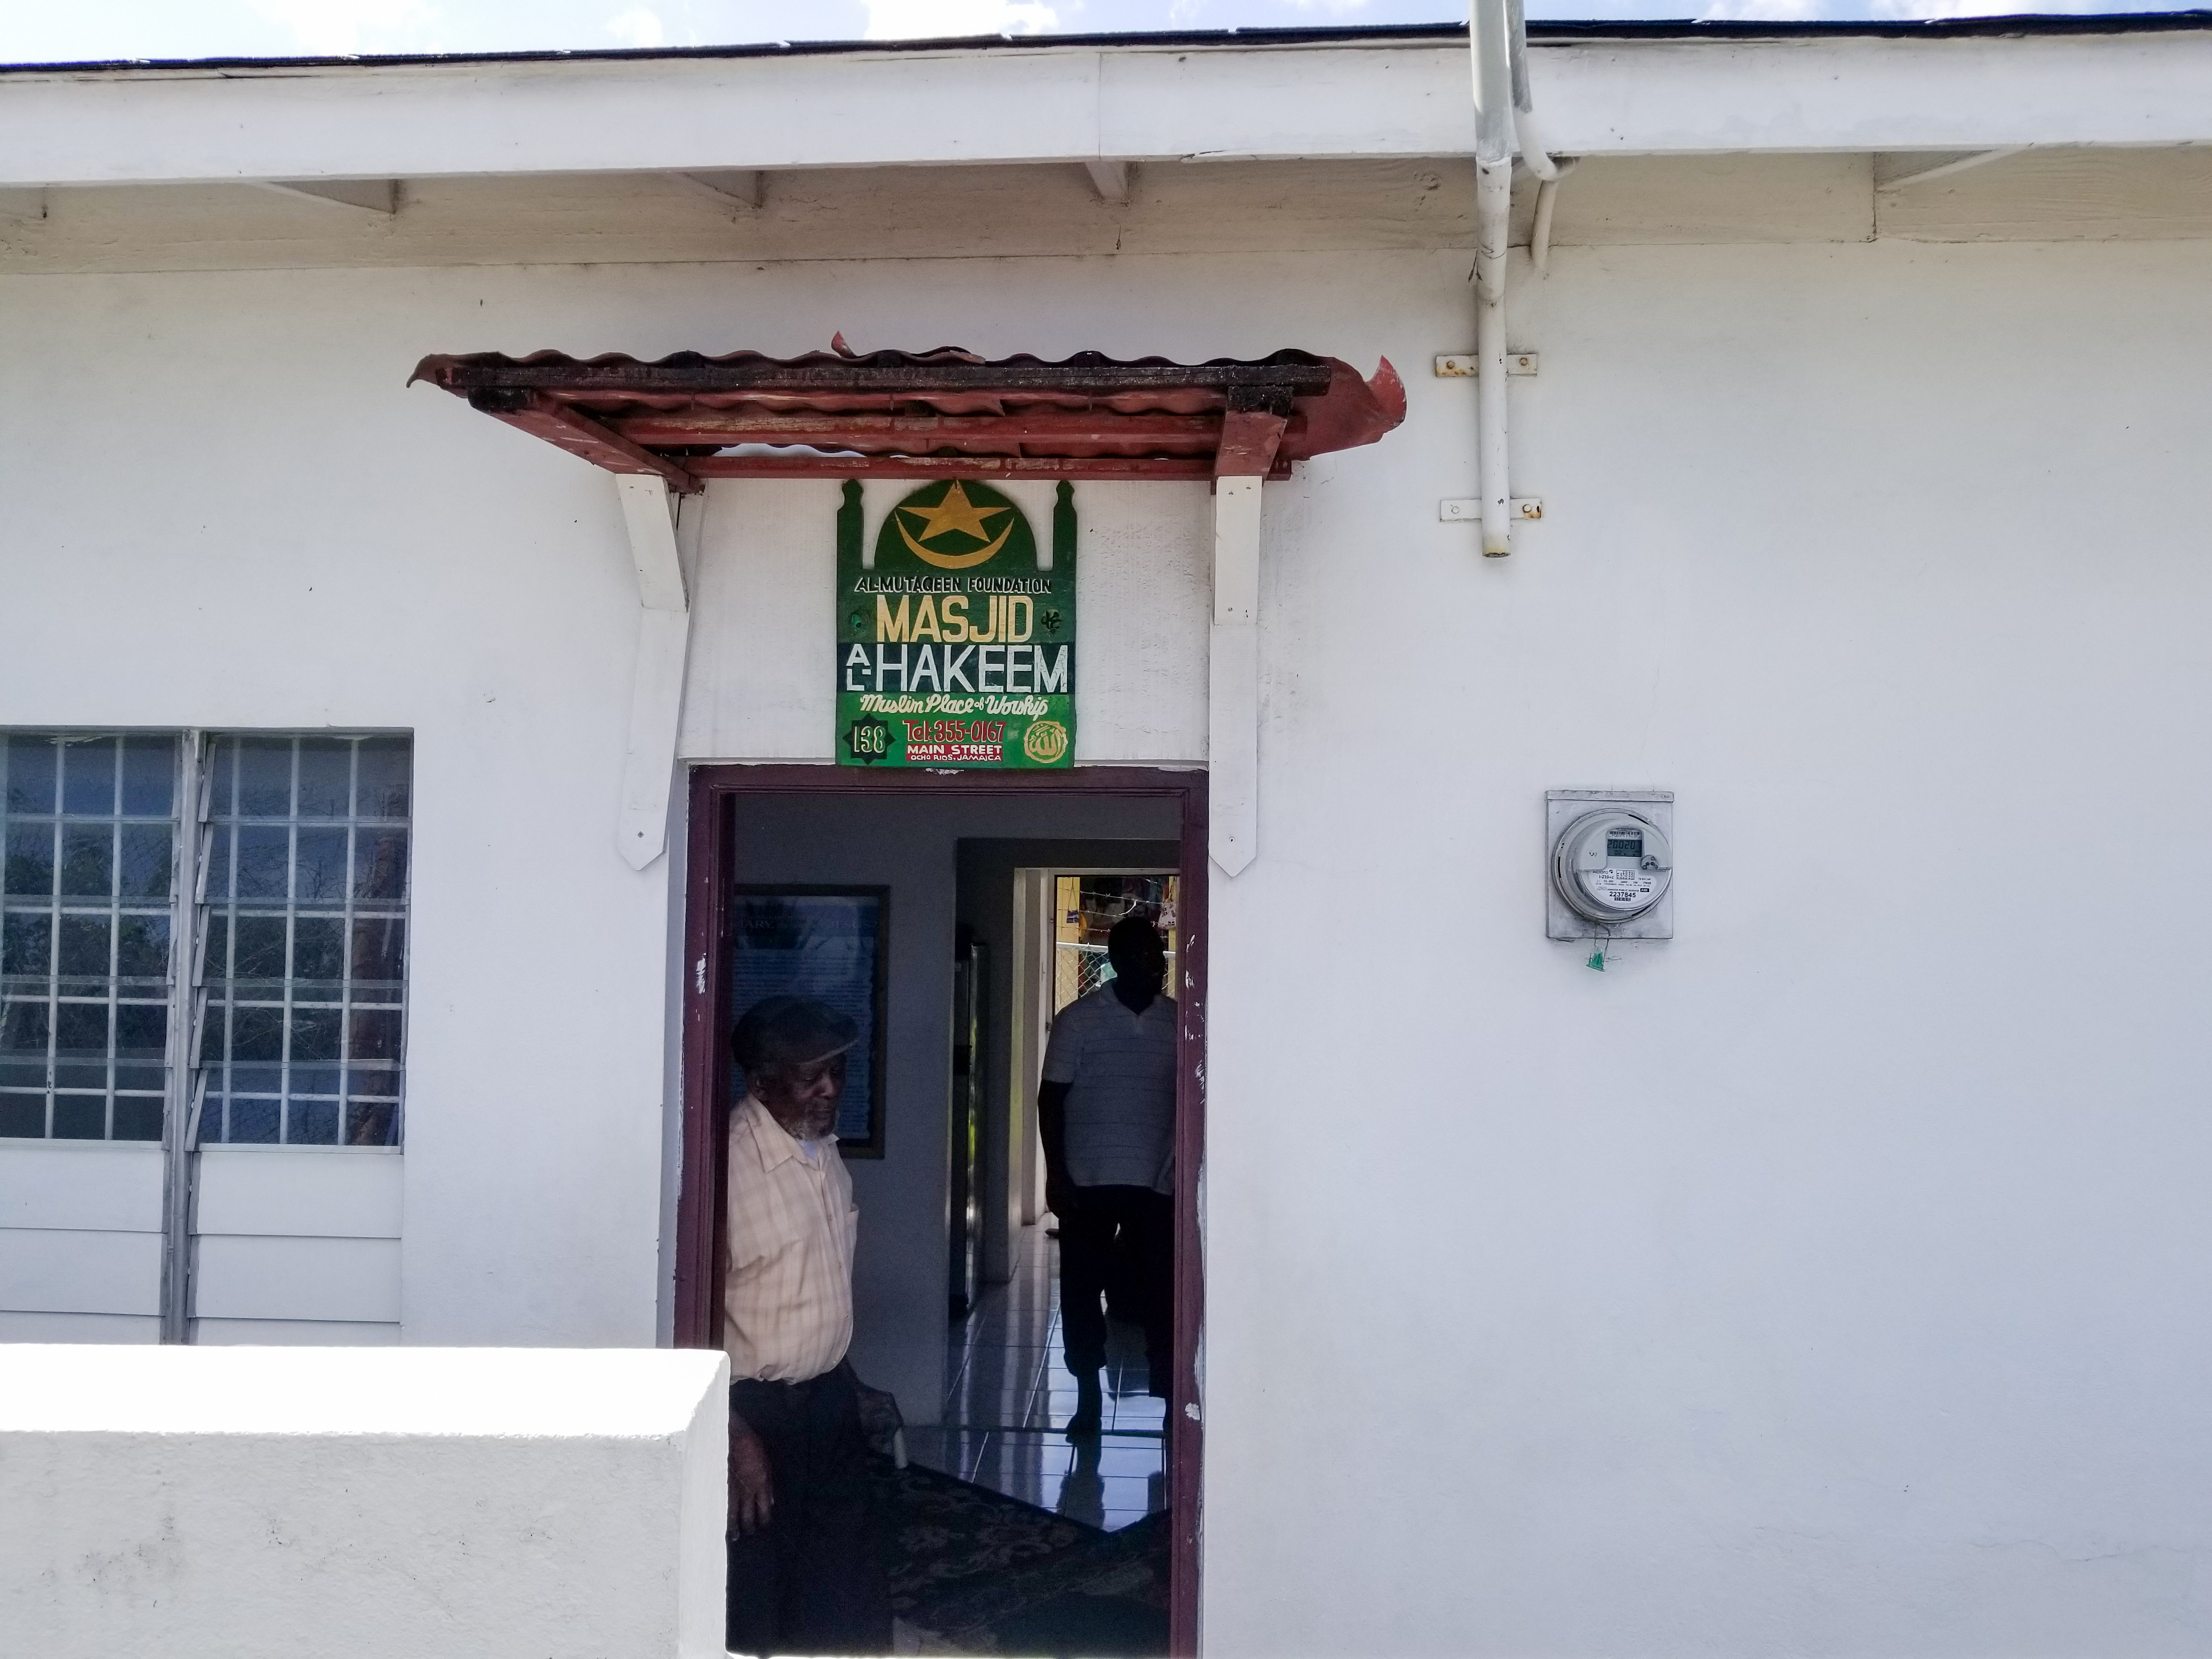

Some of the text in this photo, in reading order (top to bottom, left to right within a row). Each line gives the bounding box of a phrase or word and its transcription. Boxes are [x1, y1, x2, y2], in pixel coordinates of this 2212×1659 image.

[854, 575, 1052, 594] AL-MUTAQEEN FOUNDATION
[877, 594, 1034, 643] MASJID
[876, 644, 1068, 693] HAKEEM
[924, 694, 974, 714] Place
[975, 698, 984, 710] of
[985, 695, 1048, 721] Worship
[907, 744, 1002, 754] MAIN STREET
